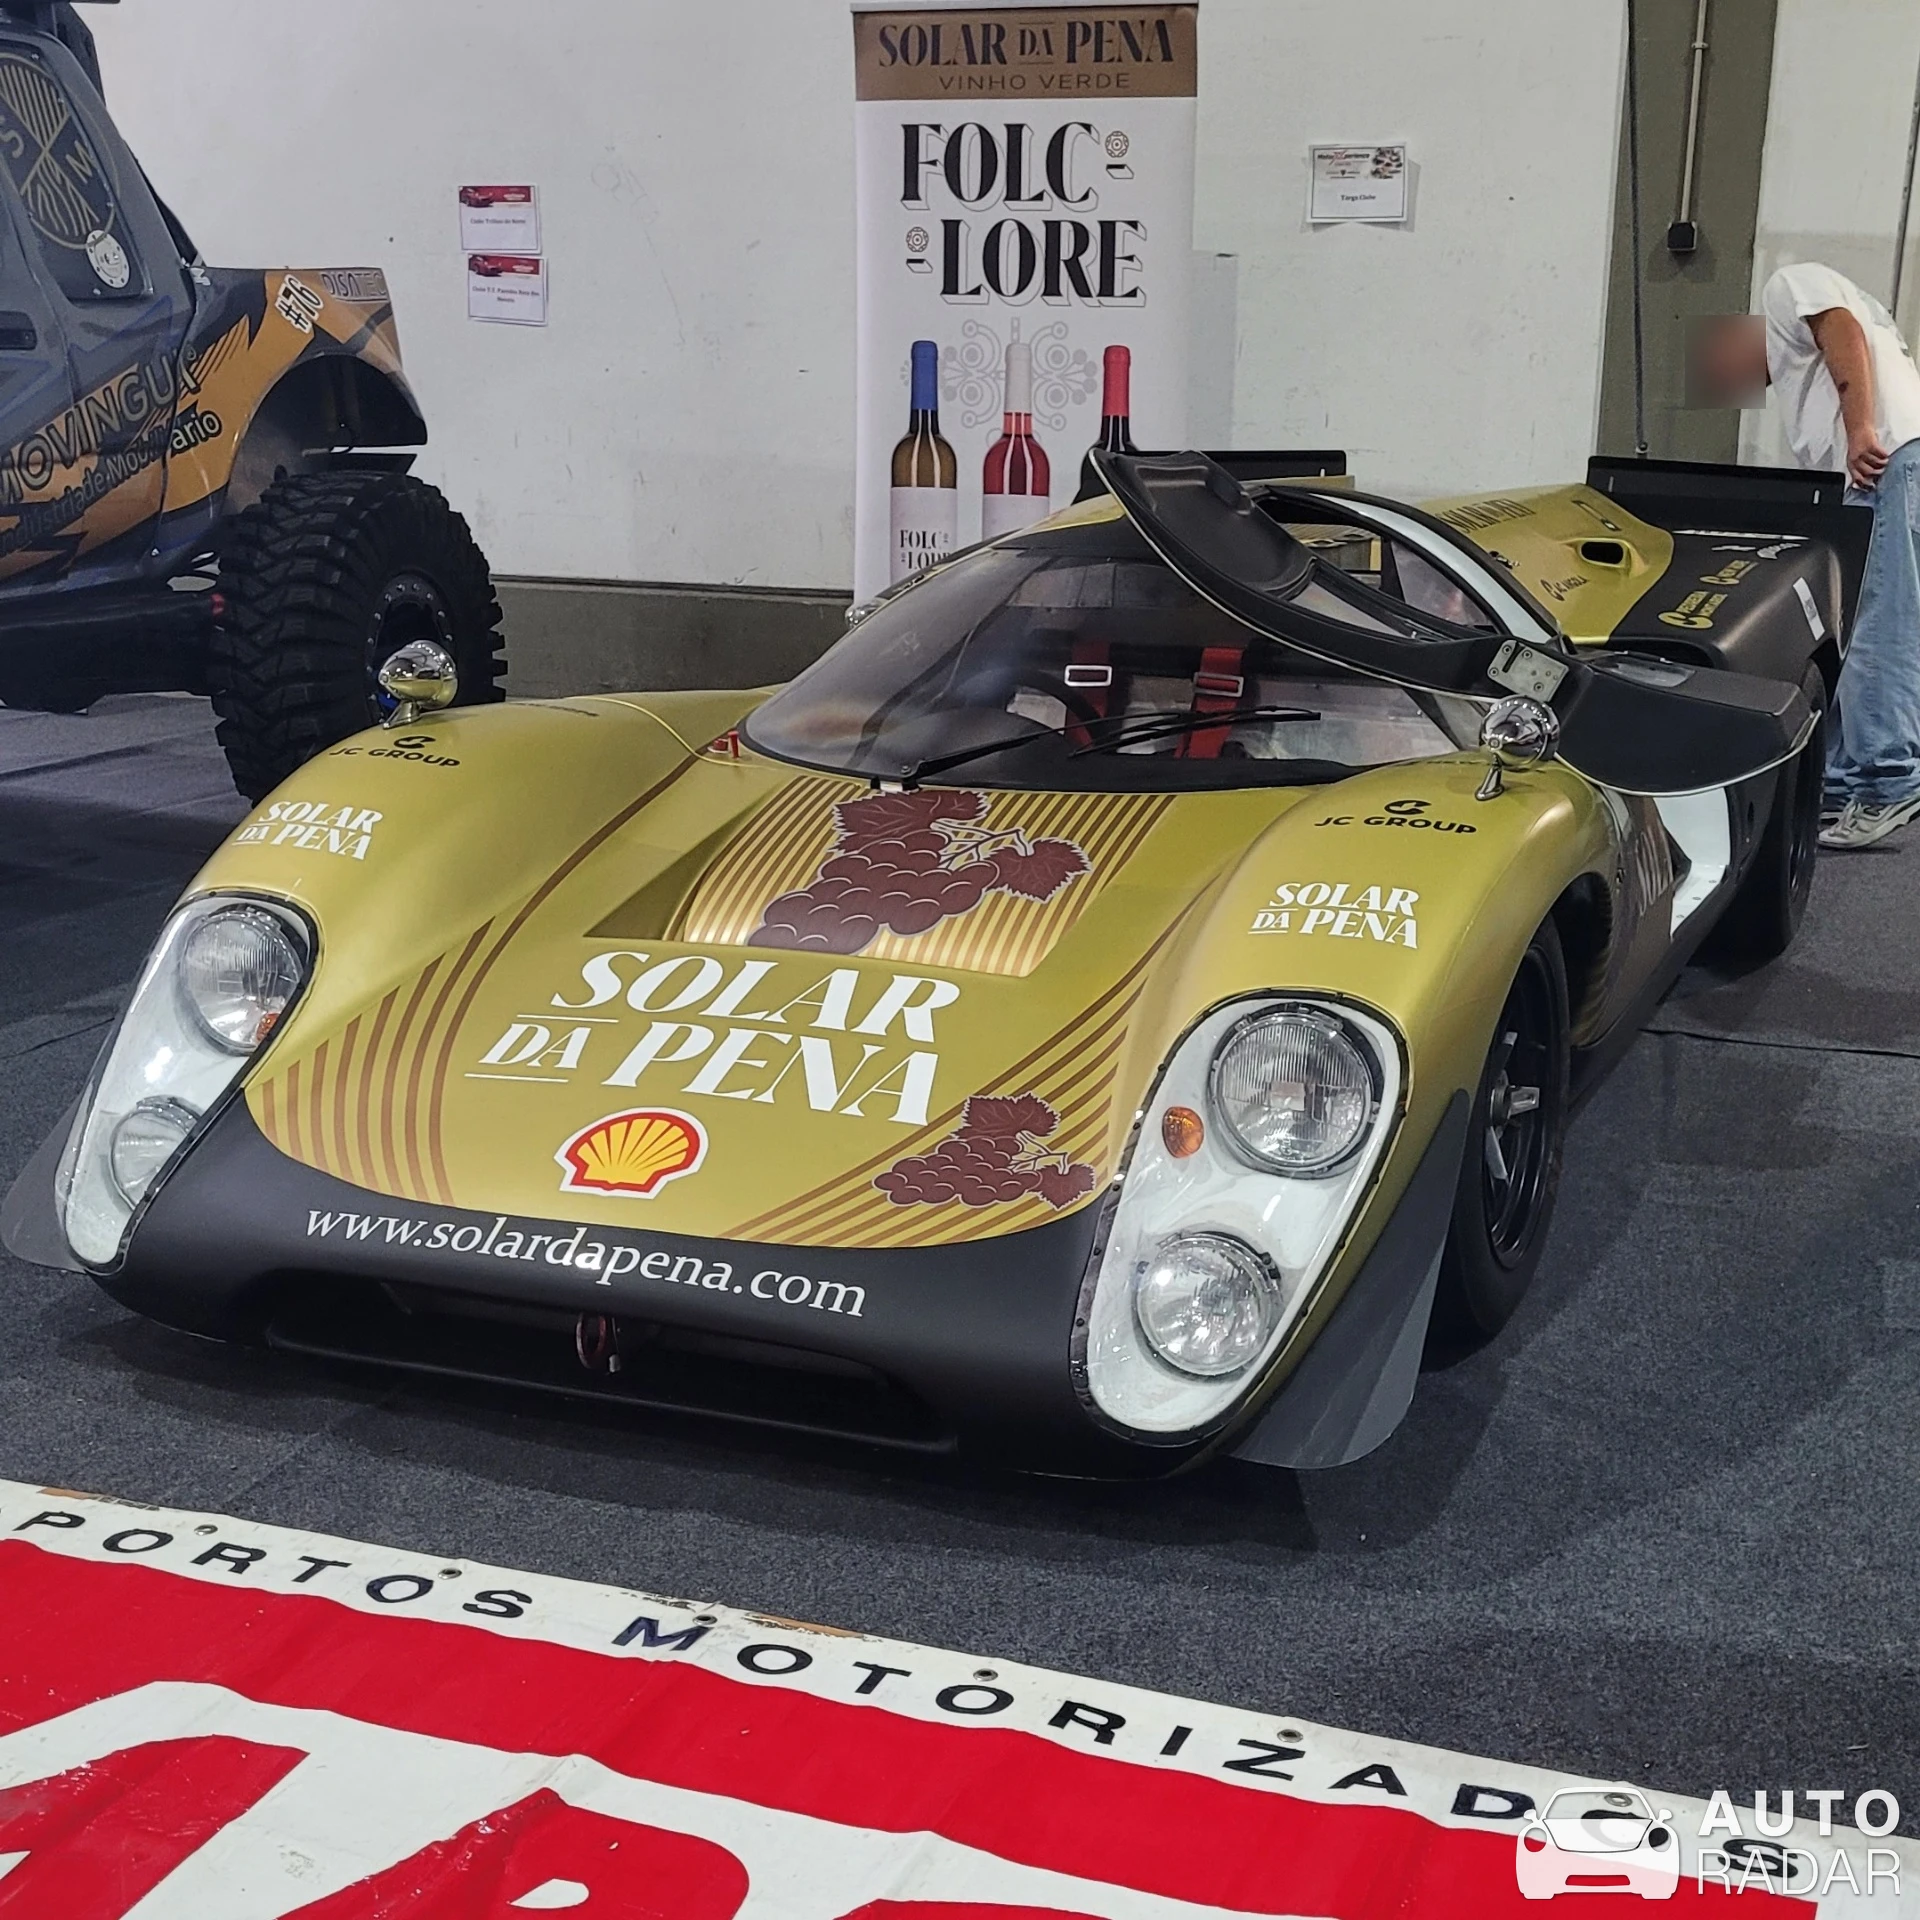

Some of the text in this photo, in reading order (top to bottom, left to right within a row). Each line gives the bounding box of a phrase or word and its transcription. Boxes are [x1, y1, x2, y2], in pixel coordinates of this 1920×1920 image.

[879, 18, 1174, 68] SOLAR DA PENA
[939, 72, 1131, 91] VINHO VERDE
[320, 271, 387, 297] DISATEC
[277, 276, 322, 331] #76
[329, 747, 461, 768] JC GROUP
[259, 800, 383, 837] SOLAR
[1314, 815, 1477, 834] JC GROUP
[238, 823, 372, 860] DA PENA
[1269, 882, 1420, 917] SOLAR
[1250, 910, 1419, 949] DA PENA
[551, 950, 960, 1043] SOLAR
[479, 1021, 940, 1127] DA PENA
[305, 1207, 867, 1318] www.solardapena.com
[611, 1614, 1799, 1880] MOTORIZADOS
